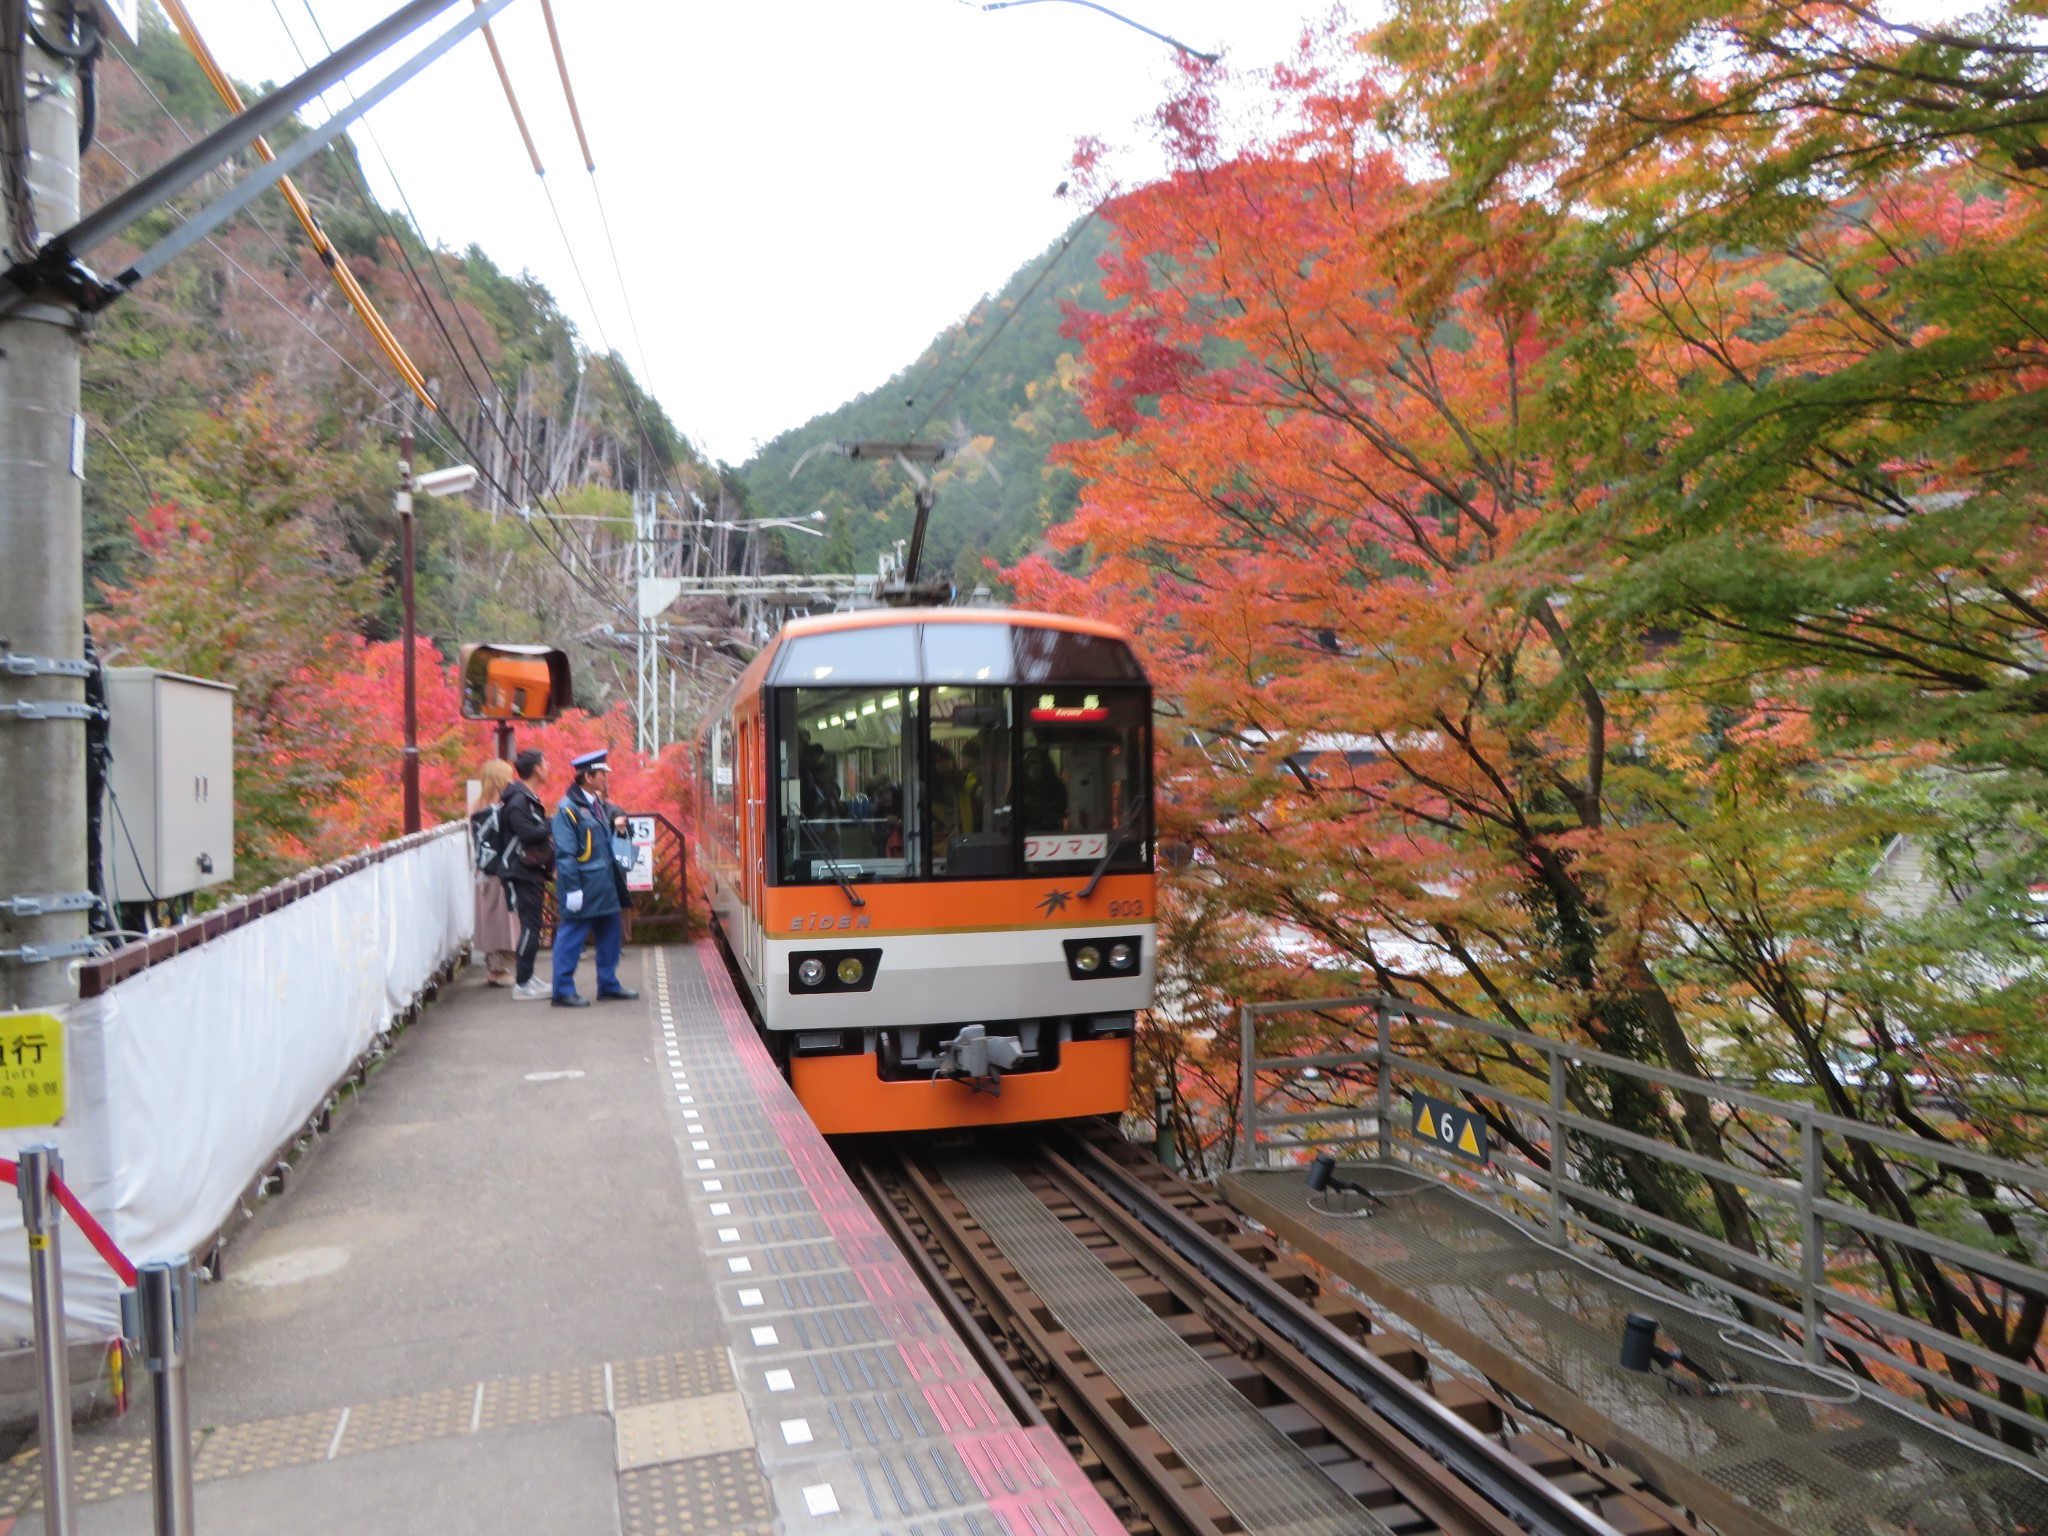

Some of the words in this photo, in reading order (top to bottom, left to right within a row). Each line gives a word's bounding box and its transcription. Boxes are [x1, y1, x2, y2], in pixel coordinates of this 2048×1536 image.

[1024, 839, 1104, 858] ワンマン
[1109, 899, 1144, 918] 903
[1441, 1112, 1454, 1143] 6
